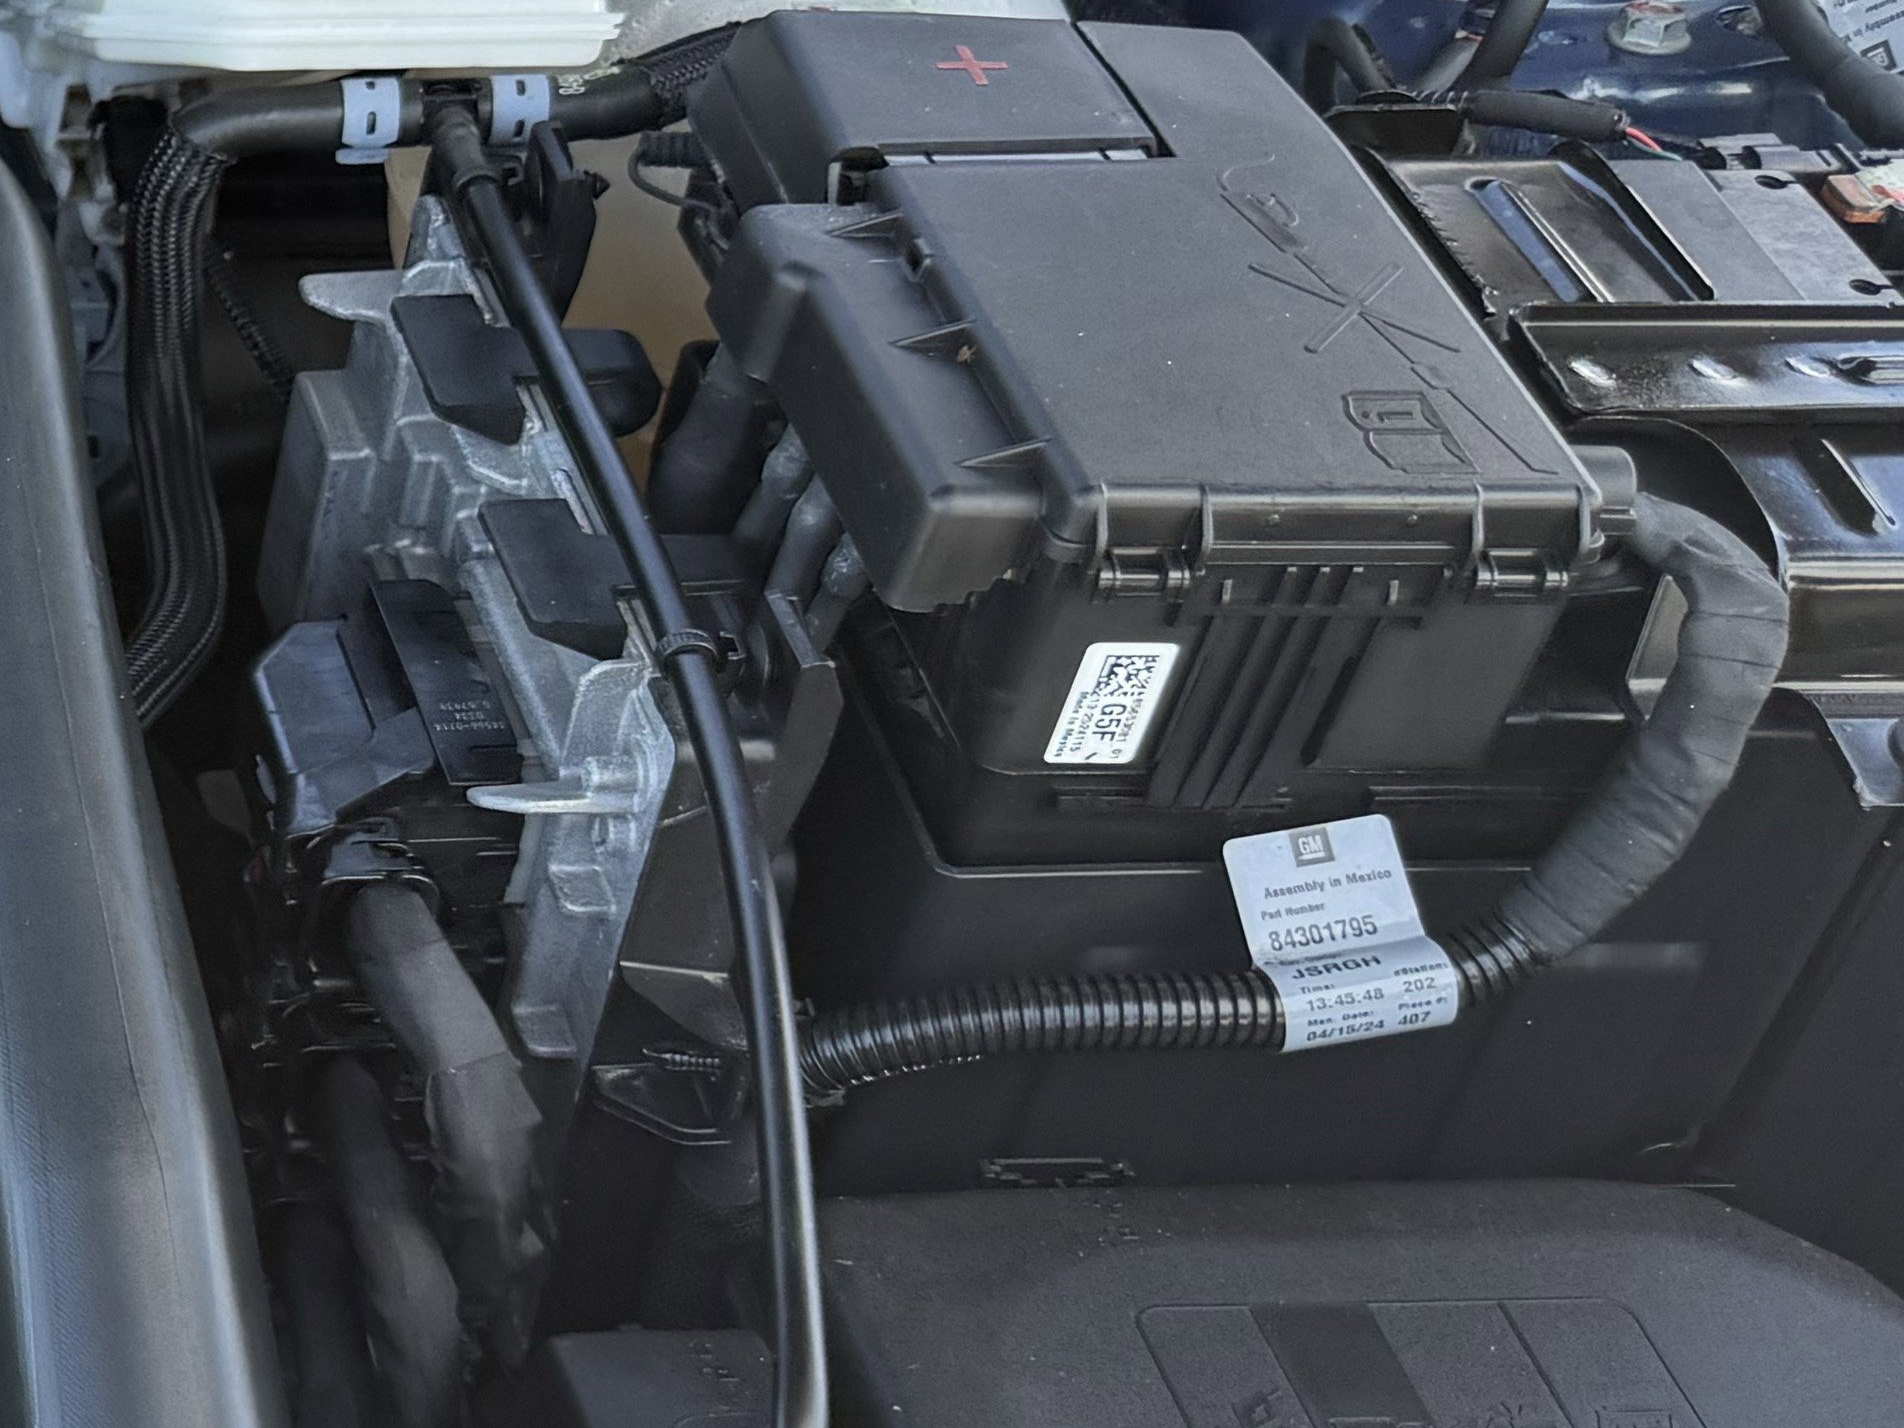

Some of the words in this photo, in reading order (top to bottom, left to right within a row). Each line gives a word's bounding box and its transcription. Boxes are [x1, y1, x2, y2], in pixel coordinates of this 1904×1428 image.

[1092, 703, 1127, 741] G5F
[1298, 834, 1324, 855] GM
[1263, 879, 1325, 900] Assembly
[1329, 876, 1342, 888] in
[1345, 869, 1392, 885] Mexico
[1260, 909, 1282, 921] Part
[1284, 902, 1325, 917] Number
[1268, 914, 1379, 952] 84301795
[1306, 988, 1385, 1013] 13:45:48
[1402, 976, 1438, 994] 202
[1306, 1019, 1385, 1043] 04/15/24
[1398, 1011, 1432, 1028] 407
